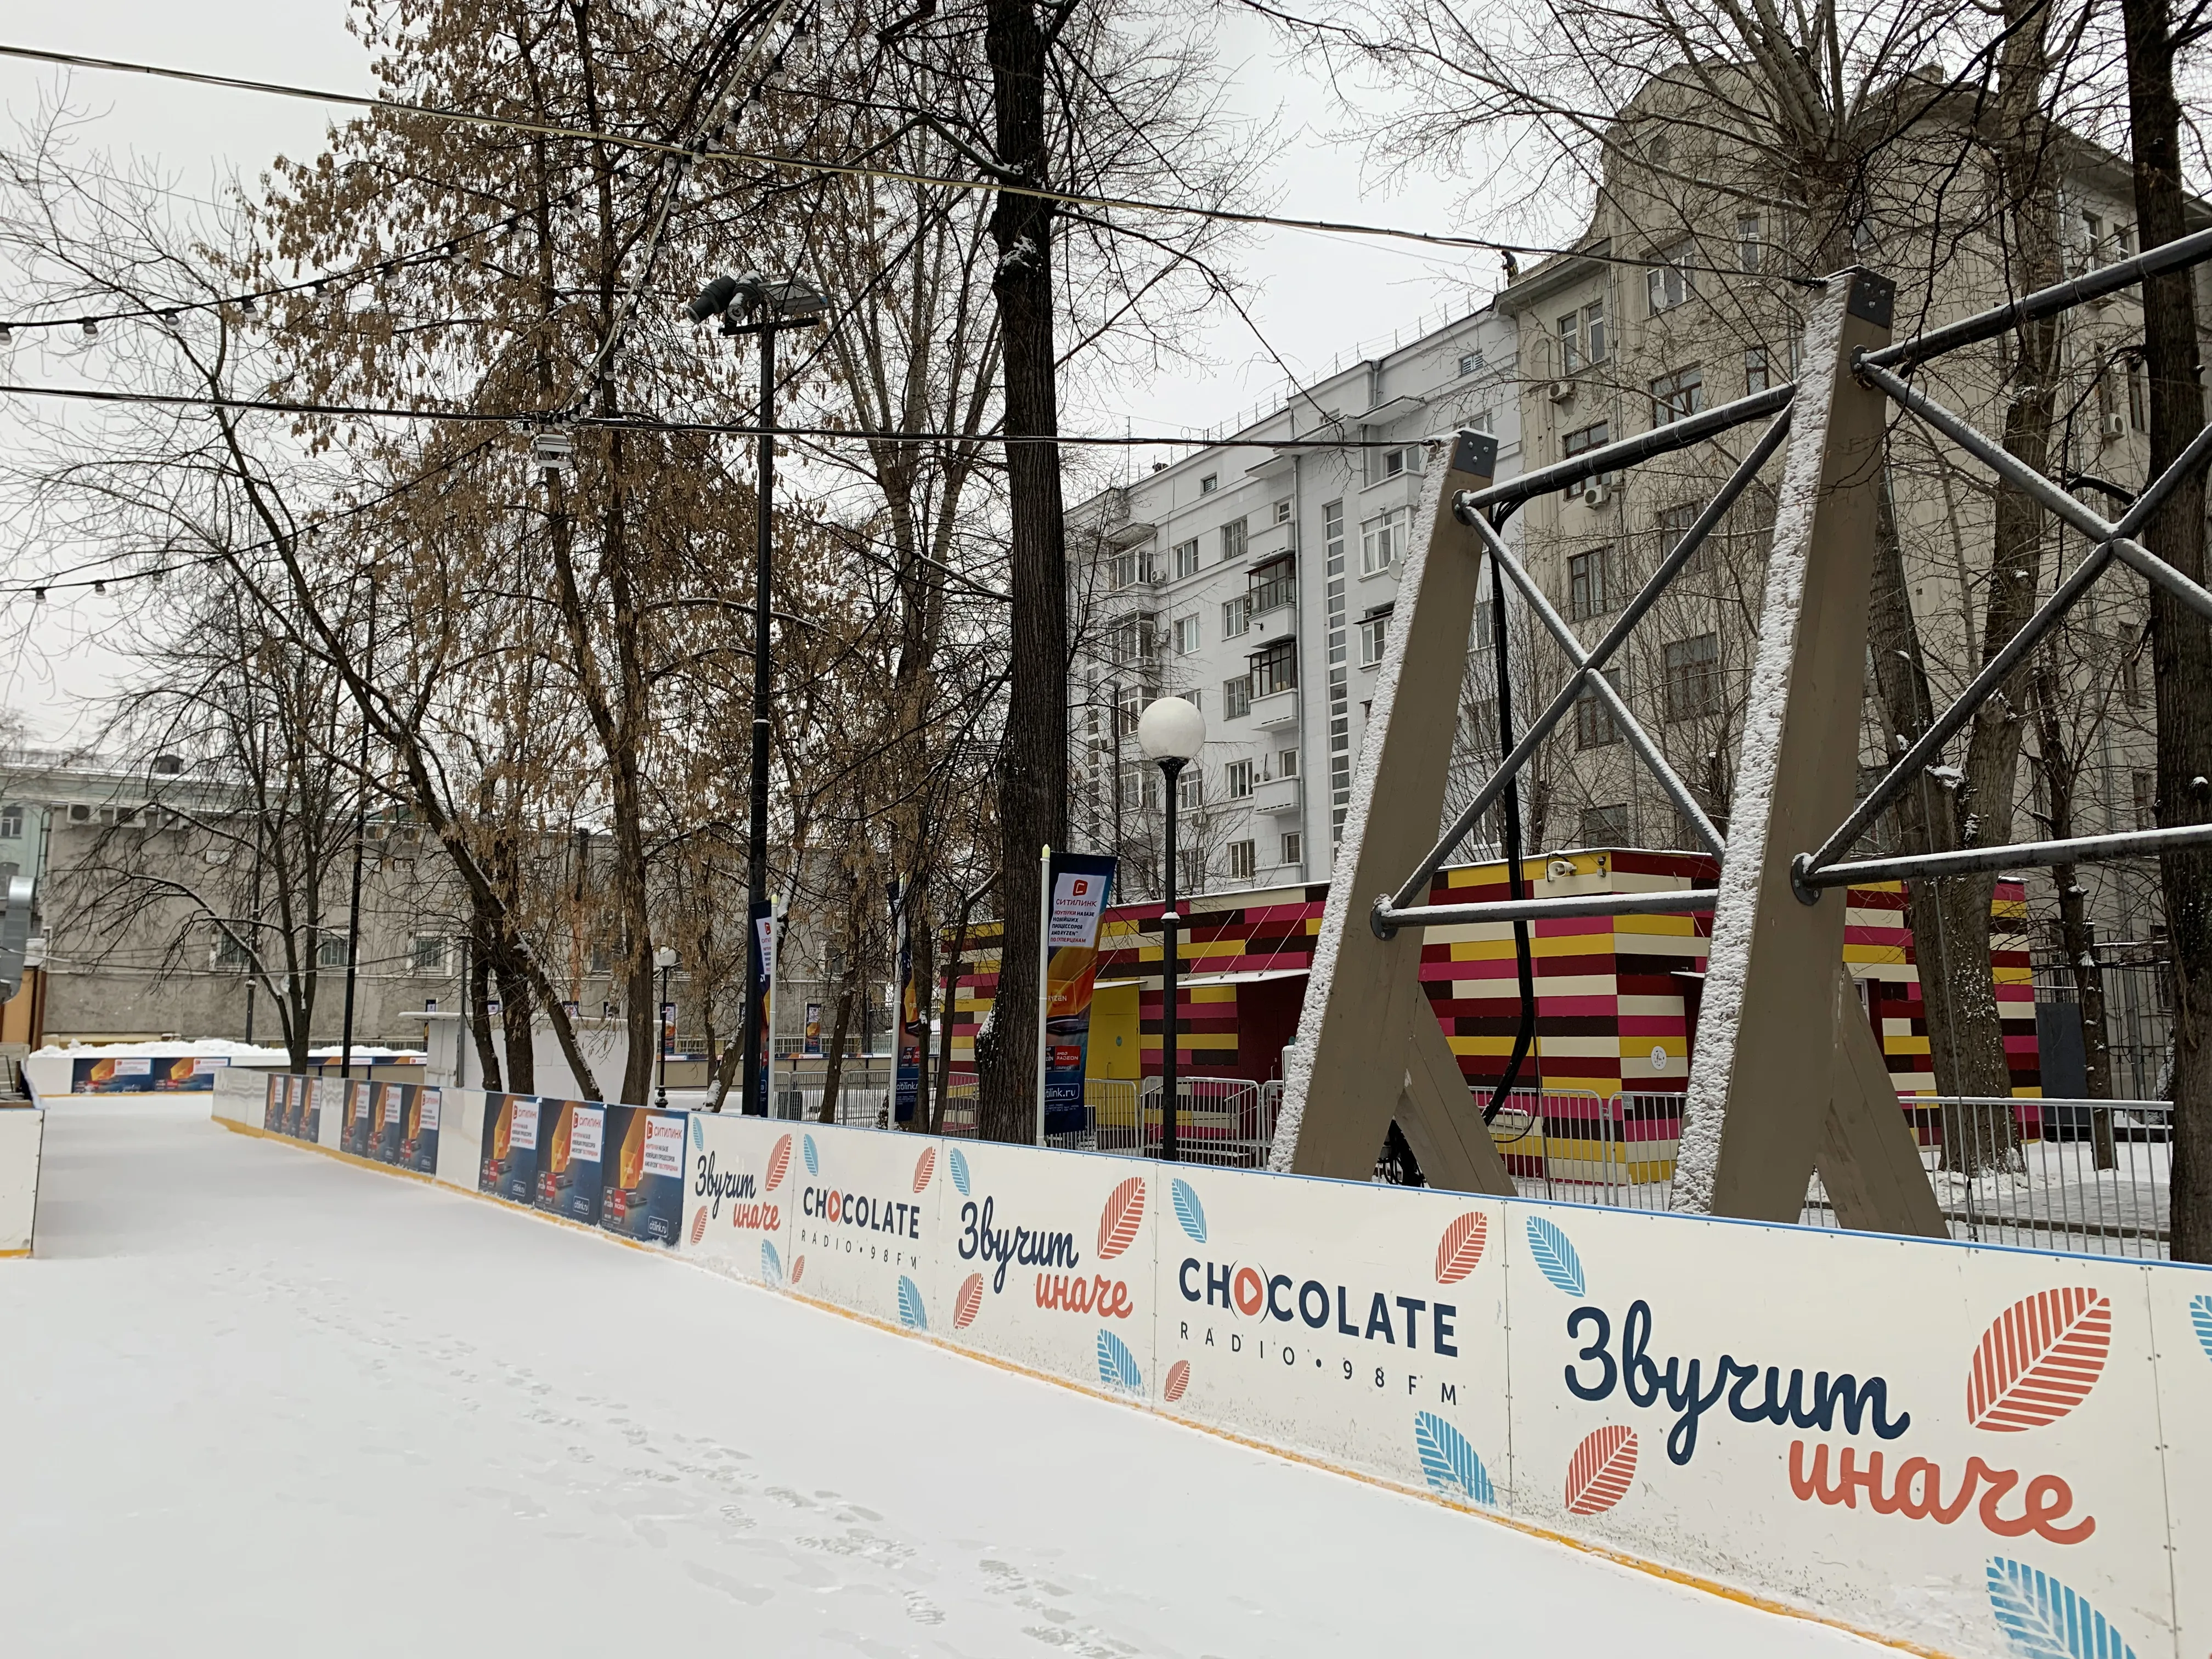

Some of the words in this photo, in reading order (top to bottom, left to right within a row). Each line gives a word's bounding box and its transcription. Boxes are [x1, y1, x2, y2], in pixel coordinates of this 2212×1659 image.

[1056, 899, 1097, 907] СИТИЛИНК
[654, 1126, 682, 1139] СИТИЛИНК
[695, 1150, 757, 1220] Звучит
[803, 1186, 920, 1239] CHOCOLATE
[733, 1201, 781, 1232] иначе
[958, 1196, 1079, 1294] Звучит
[1036, 1272, 1133, 1319] иначе
[1179, 1257, 1458, 1358] CHOCOLATE
[1565, 1300, 1910, 1465] Звучит
[1788, 1440, 2096, 1545] иначе
